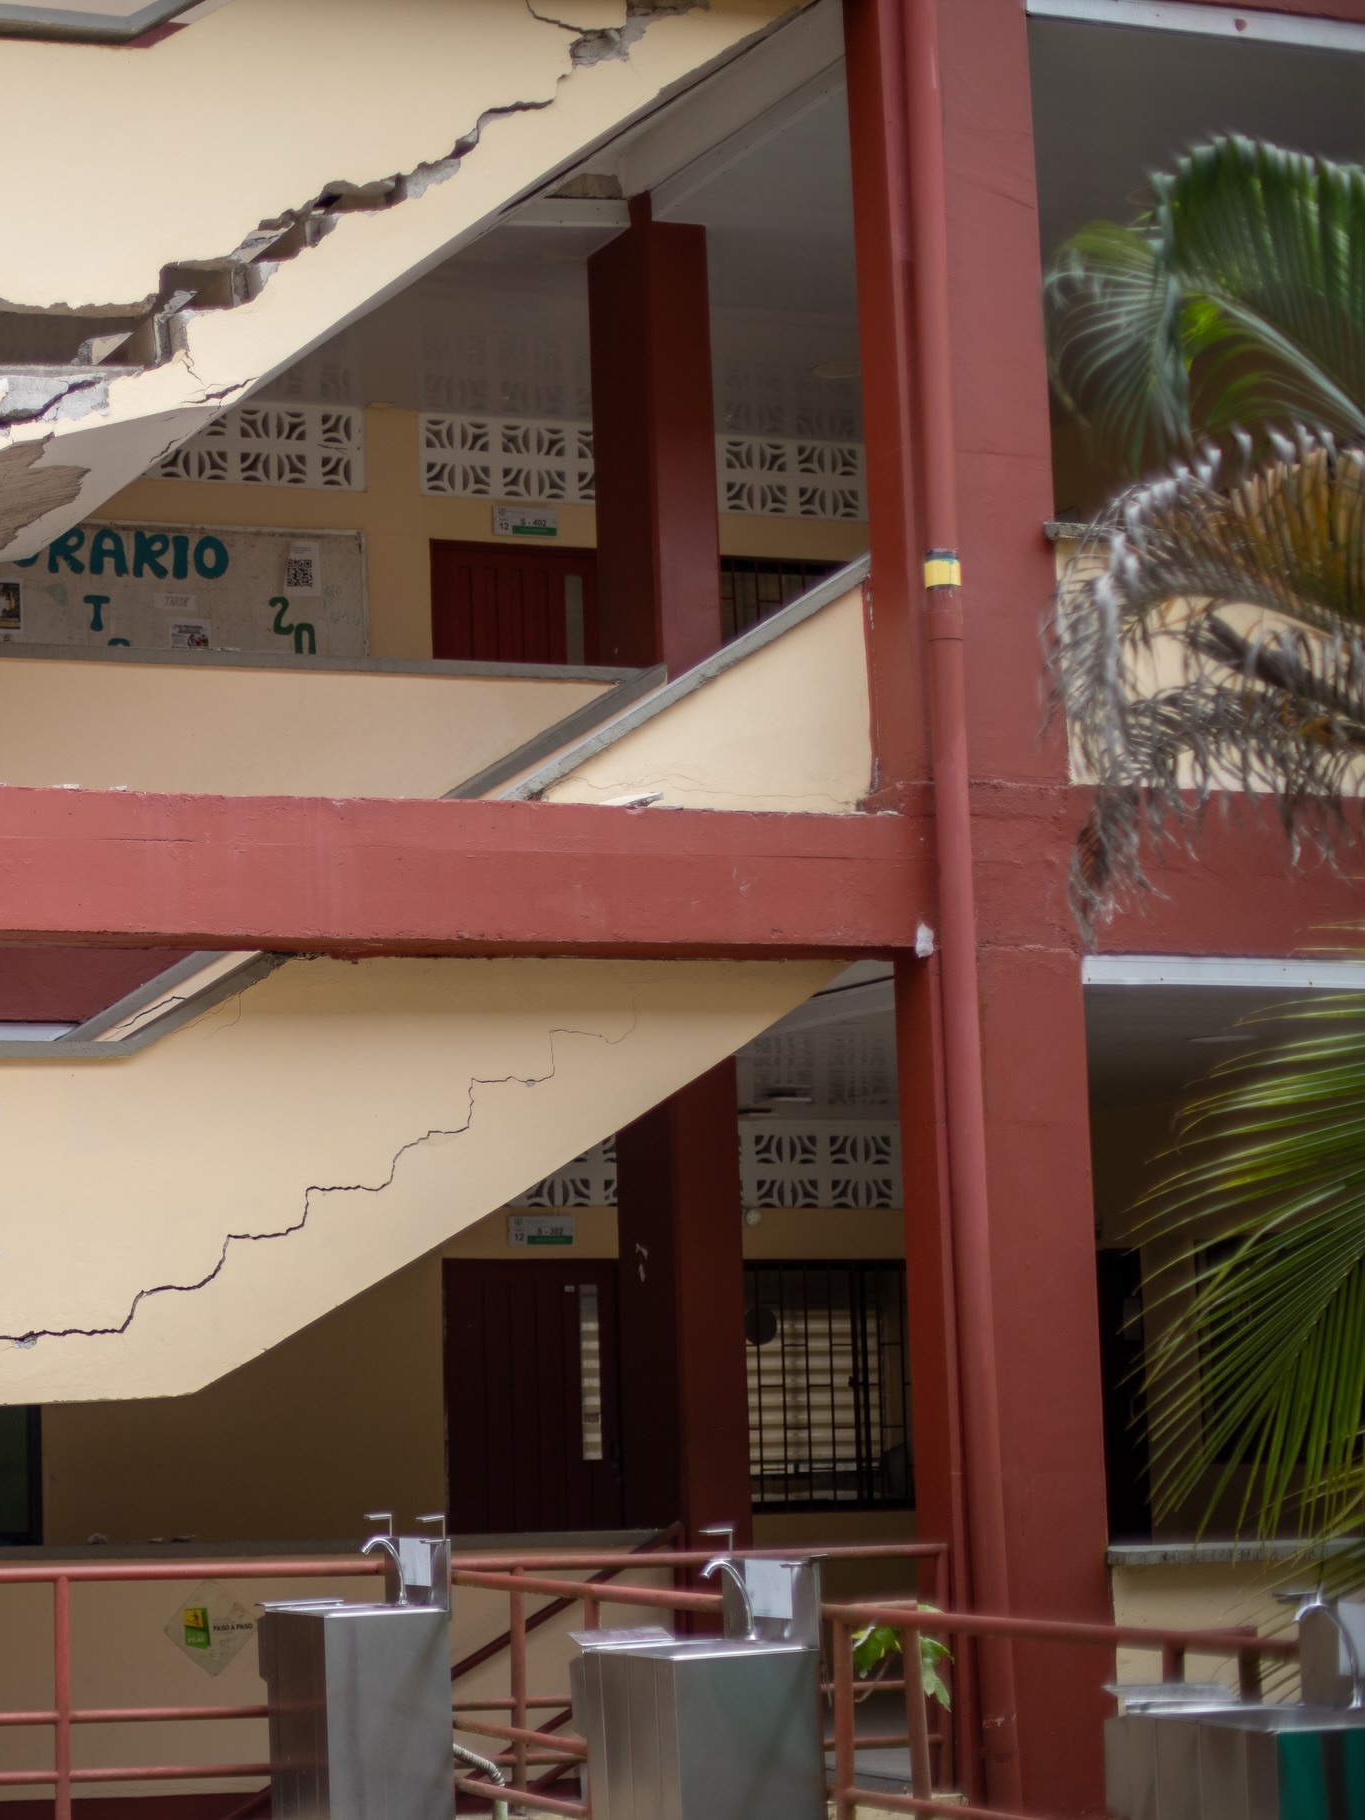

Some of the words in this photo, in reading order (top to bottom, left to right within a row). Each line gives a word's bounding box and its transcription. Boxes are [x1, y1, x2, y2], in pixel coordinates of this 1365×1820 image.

[499, 522, 509, 531] 12
[520, 518, 526, 526] S
[533, 519, 547, 527] 402
[13, 528, 229, 580] RARIO
[164, 596, 190, 608] TARDE
[550, 1227, 564, 1236] 302
[515, 1233, 525, 1242] 12
[212, 1624, 230, 1632] PASO
